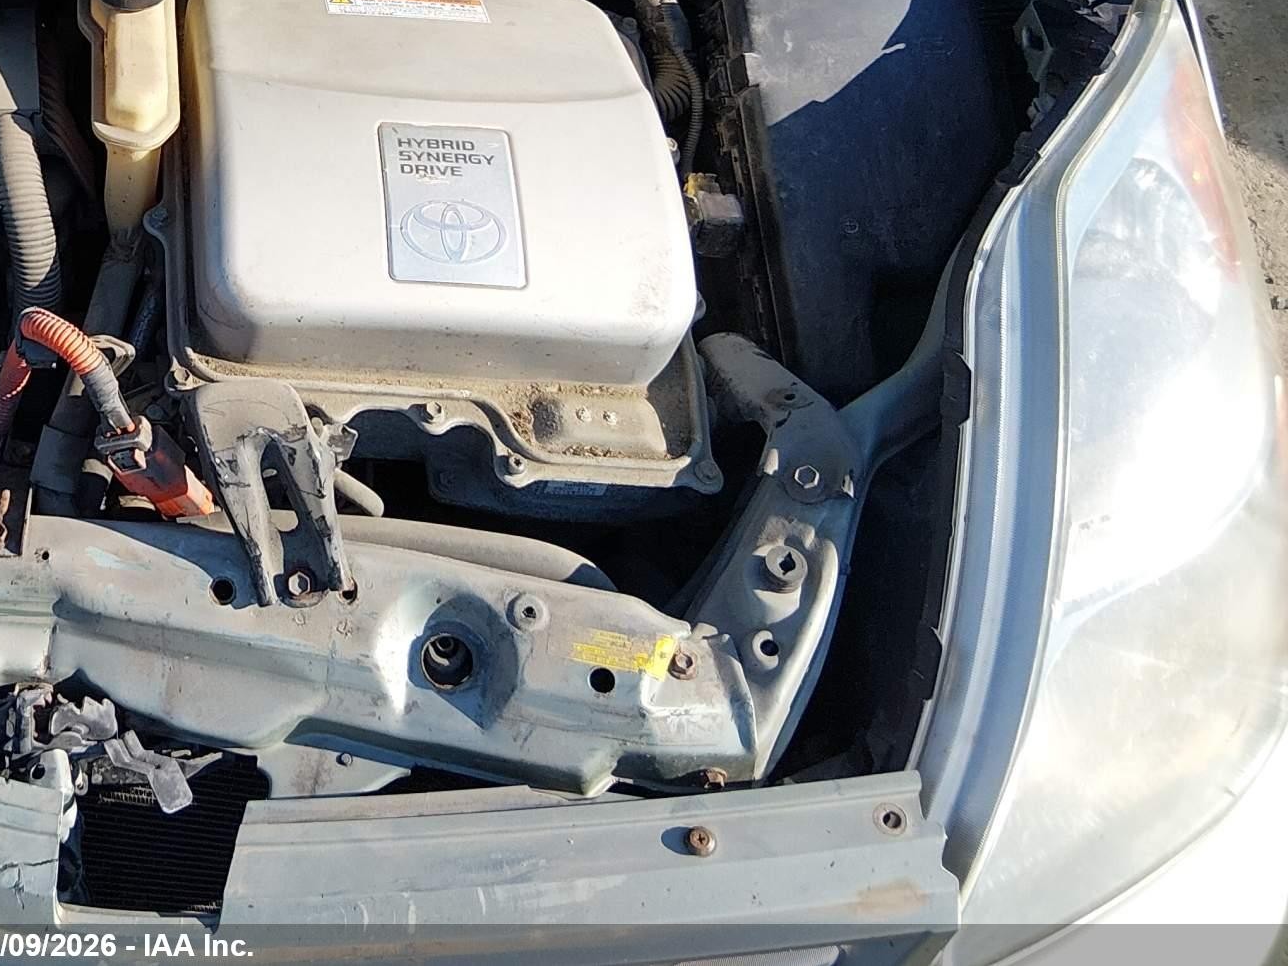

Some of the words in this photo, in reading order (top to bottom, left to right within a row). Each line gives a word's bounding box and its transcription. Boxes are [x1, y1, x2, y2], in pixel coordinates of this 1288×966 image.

[397, 138, 475, 151] HYBRID
[399, 151, 494, 165] SYNERGY
[400, 164, 463, 176] DRIVE
